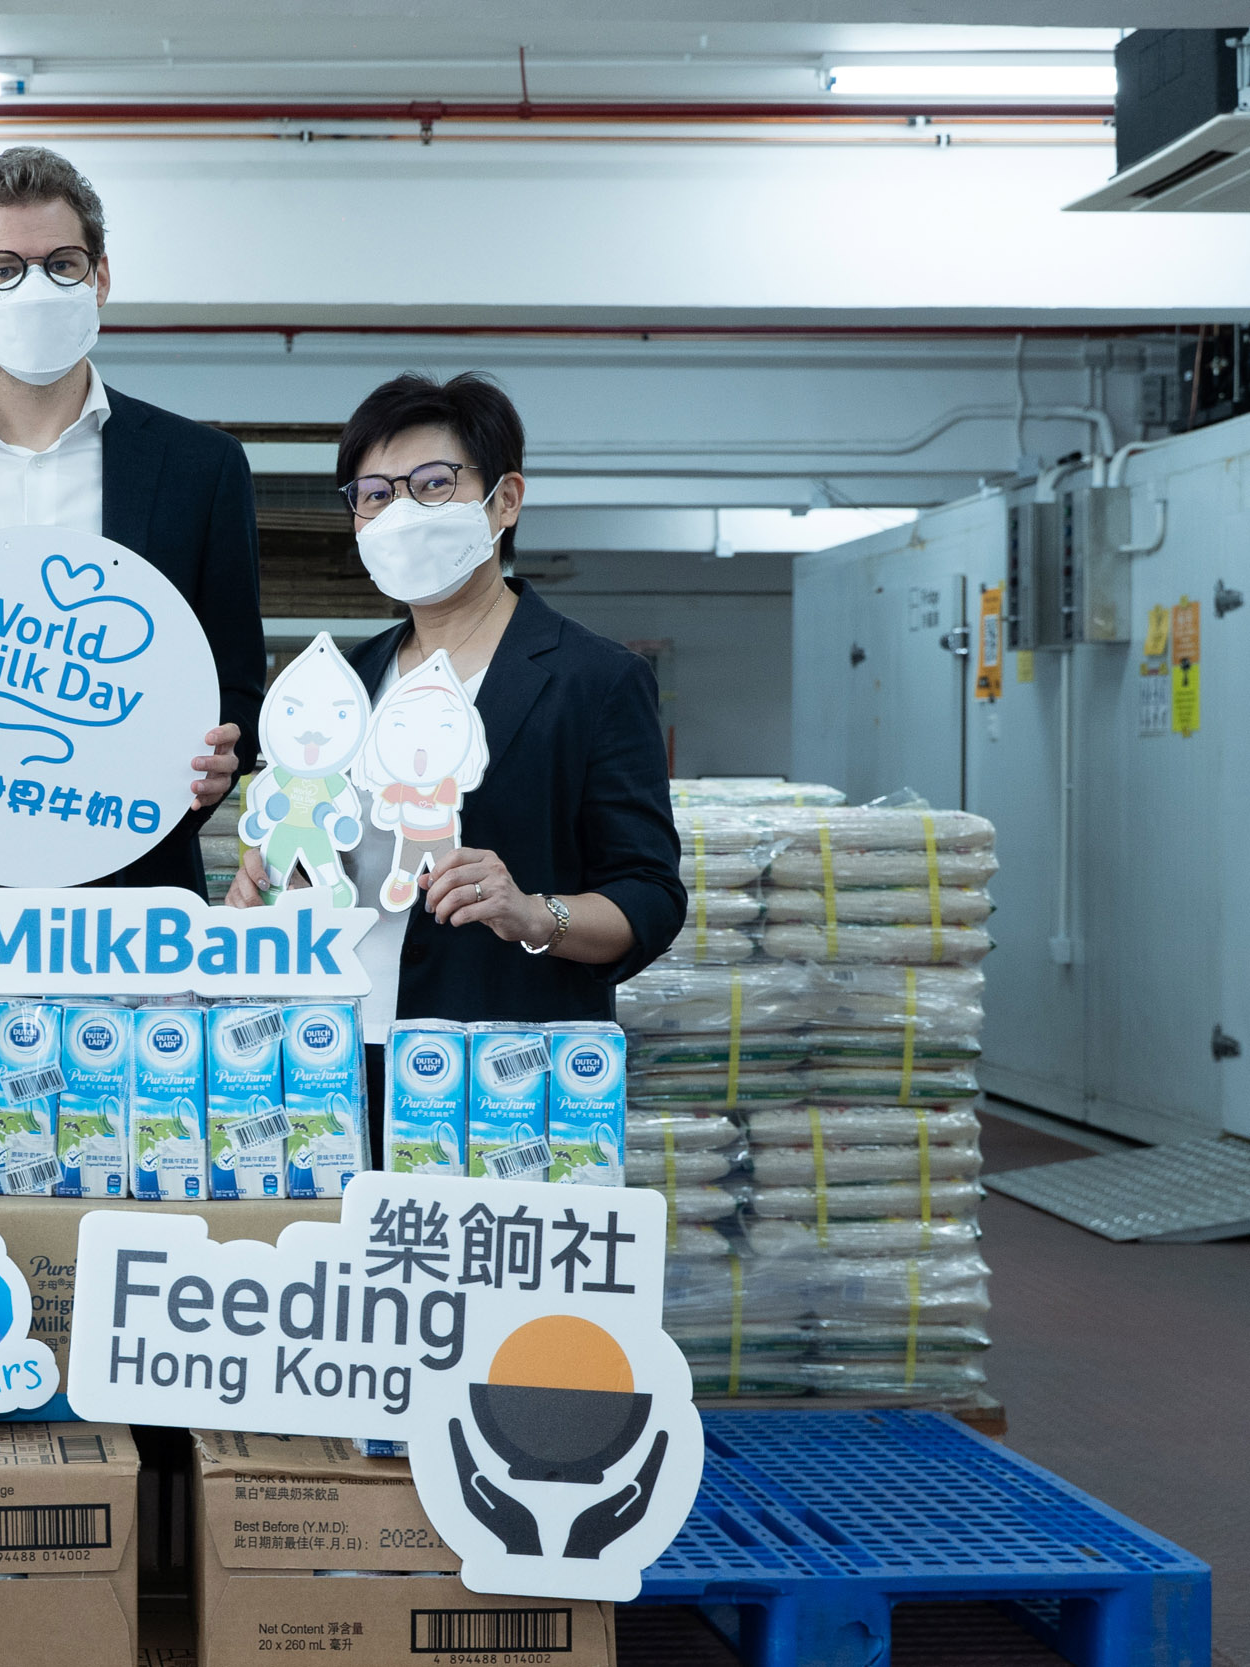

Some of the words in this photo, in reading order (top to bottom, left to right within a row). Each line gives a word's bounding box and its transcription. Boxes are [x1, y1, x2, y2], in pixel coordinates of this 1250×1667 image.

[57, 661, 144, 722] Day
[13, 1028, 37, 1036] DUTCH
[68, 1068, 123, 1083] PureFarm
[139, 1071, 196, 1085] PureFarm
[215, 1069, 272, 1084] PureFarm
[291, 1067, 348, 1082] PureFarm
[398, 1094, 456, 1109] PureFarm
[477, 1096, 536, 1110] PureFarm
[557, 1096, 615, 1110] PureFarm
[365, 1198, 636, 1295] 樂餉社
[30, 1255, 76, 1277] Pure
[31, 1295, 74, 1315] Origi
[113, 1248, 467, 1371] Feeding
[30, 1316, 70, 1332] Milk
[109, 1336, 248, 1405] Hong
[275, 1345, 412, 1415] Kong
[234, 1521, 259, 1532] Best
[262, 1521, 299, 1532] Before
[302, 1521, 349, 1534] (Y.M.D):
[42, 1550, 91, 1561] 014002
[258, 1623, 278, 1634] Net
[281, 1623, 324, 1635] Content
[327, 1622, 364, 1635] 淨含量
[258, 1639, 272, 1650] 20
[275, 1641, 282, 1650] x
[284, 1639, 306, 1650] 260
[309, 1639, 326, 1650] mL
[329, 1638, 354, 1651] 毫升
[433, 1654, 440, 1664] 4
[450, 1654, 497, 1664] 894488
[503, 1653, 551, 1664] 014002
